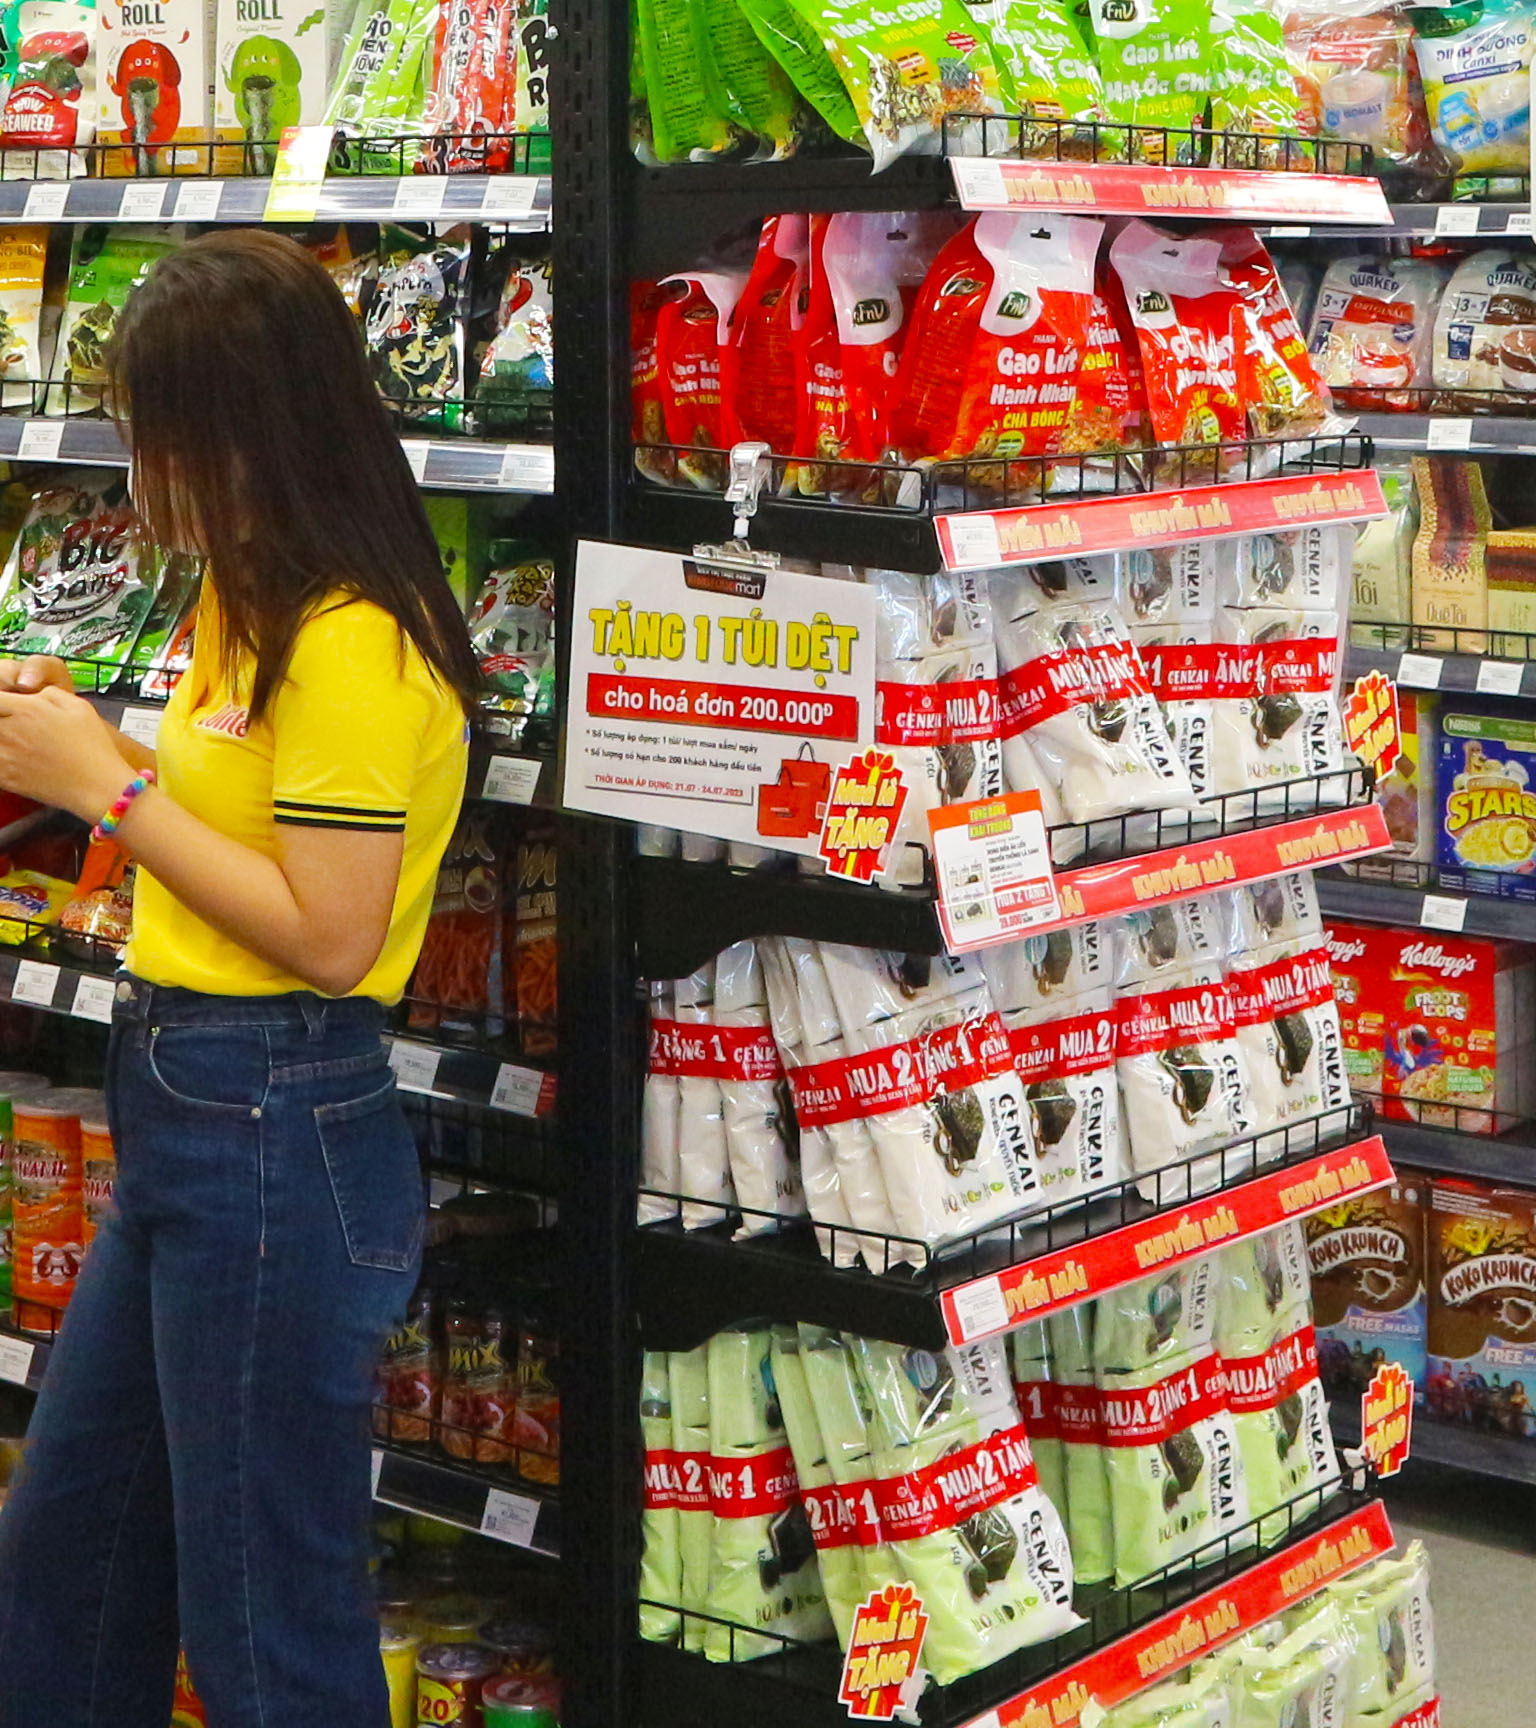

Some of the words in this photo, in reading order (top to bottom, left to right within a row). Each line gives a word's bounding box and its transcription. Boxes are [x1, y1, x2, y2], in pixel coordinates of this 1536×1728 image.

[236, 0, 283, 21] ROLL
[589, 600, 687, 671] TẶNG
[694, 616, 709, 661] 1
[718, 607, 779, 668] TÚI
[786, 612, 858, 687] DỆT
[604, 688, 645, 711] cho
[649, 688, 688, 714] hoá
[695, 692, 736, 719] đơn
[826, 806, 889, 858] TẶNG
[1399, 942, 1476, 977] Kellogg's
[1322, 1018, 1342, 1106] GENKAI
[1029, 1511, 1070, 1605] GENKAI
